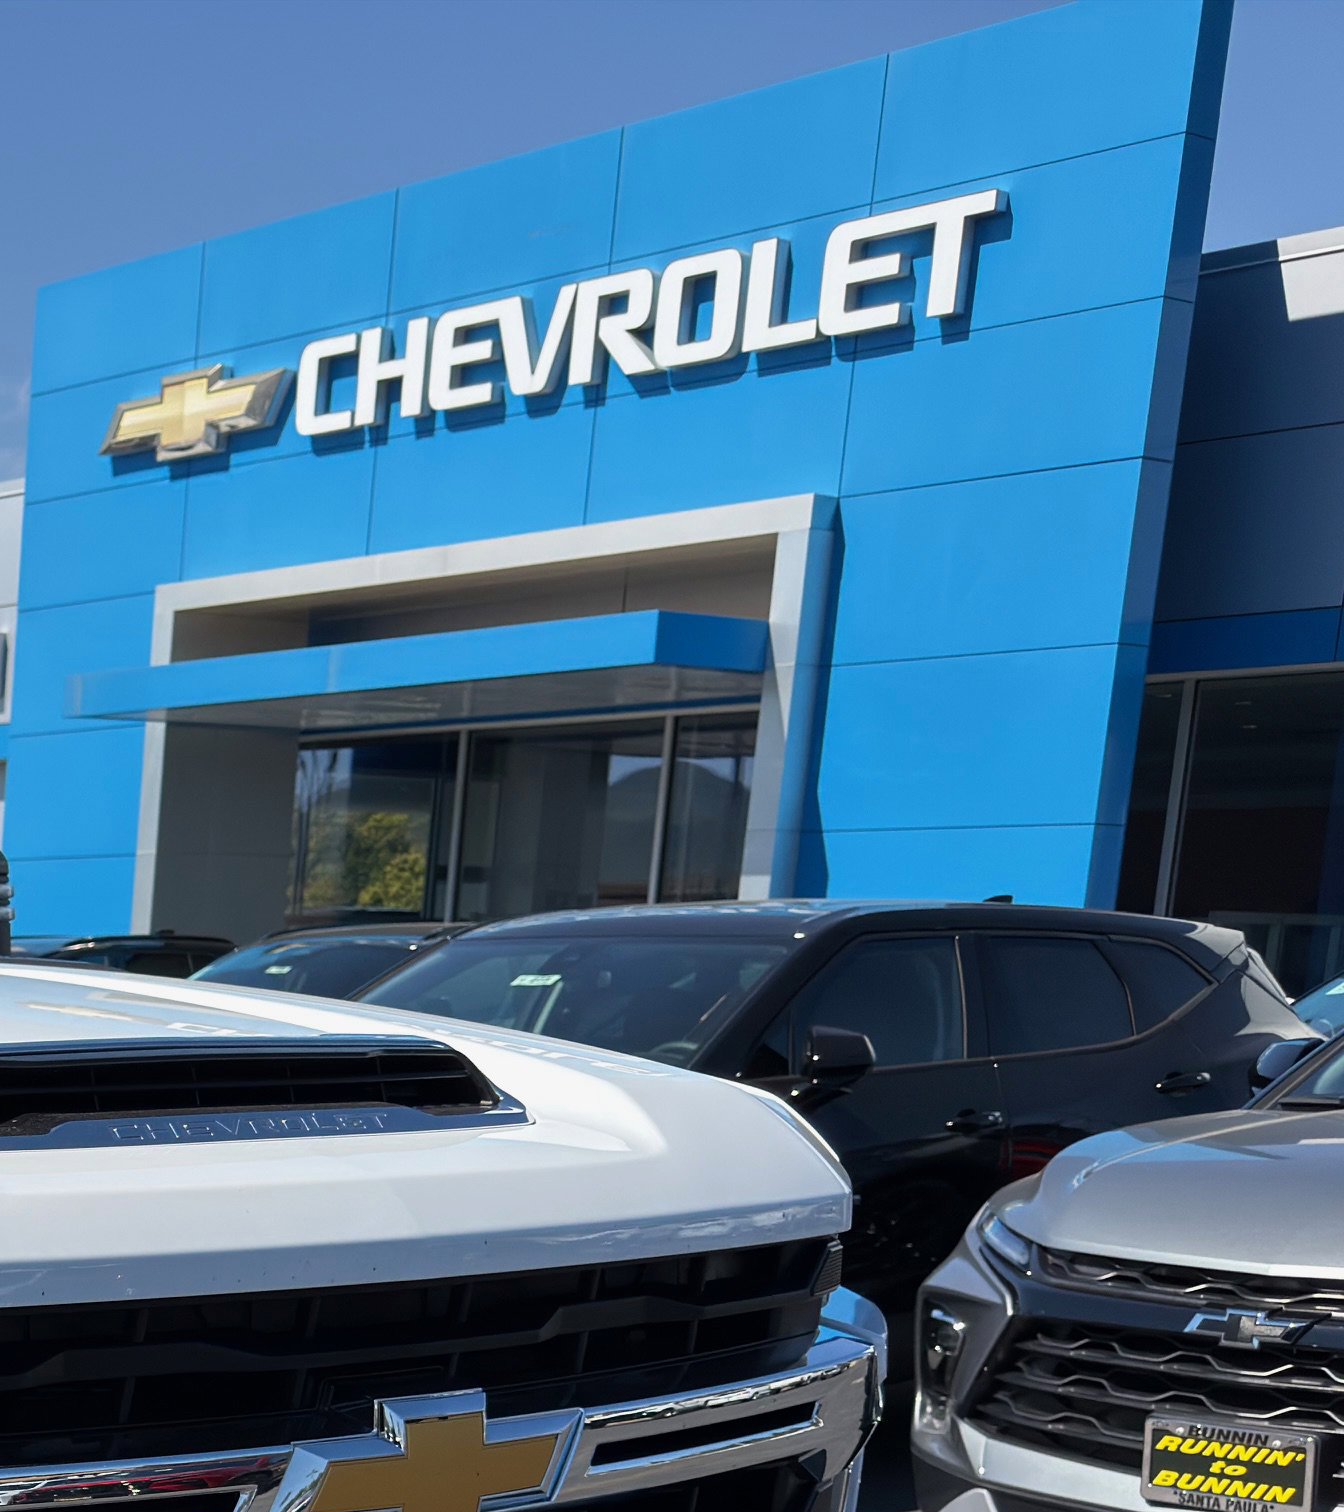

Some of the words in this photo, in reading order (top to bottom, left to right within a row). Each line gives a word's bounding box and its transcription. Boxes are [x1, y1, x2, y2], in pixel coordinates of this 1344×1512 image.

[295, 189, 1009, 436] CHEVROLET
[111, 1112, 388, 1141] CHEVROLET
[1155, 1435, 1305, 1467] RUNNIN'
[1187, 1425, 1270, 1447] BUNNIN
[1209, 1460, 1248, 1477] to
[1152, 1469, 1297, 1504] BUNNIN
